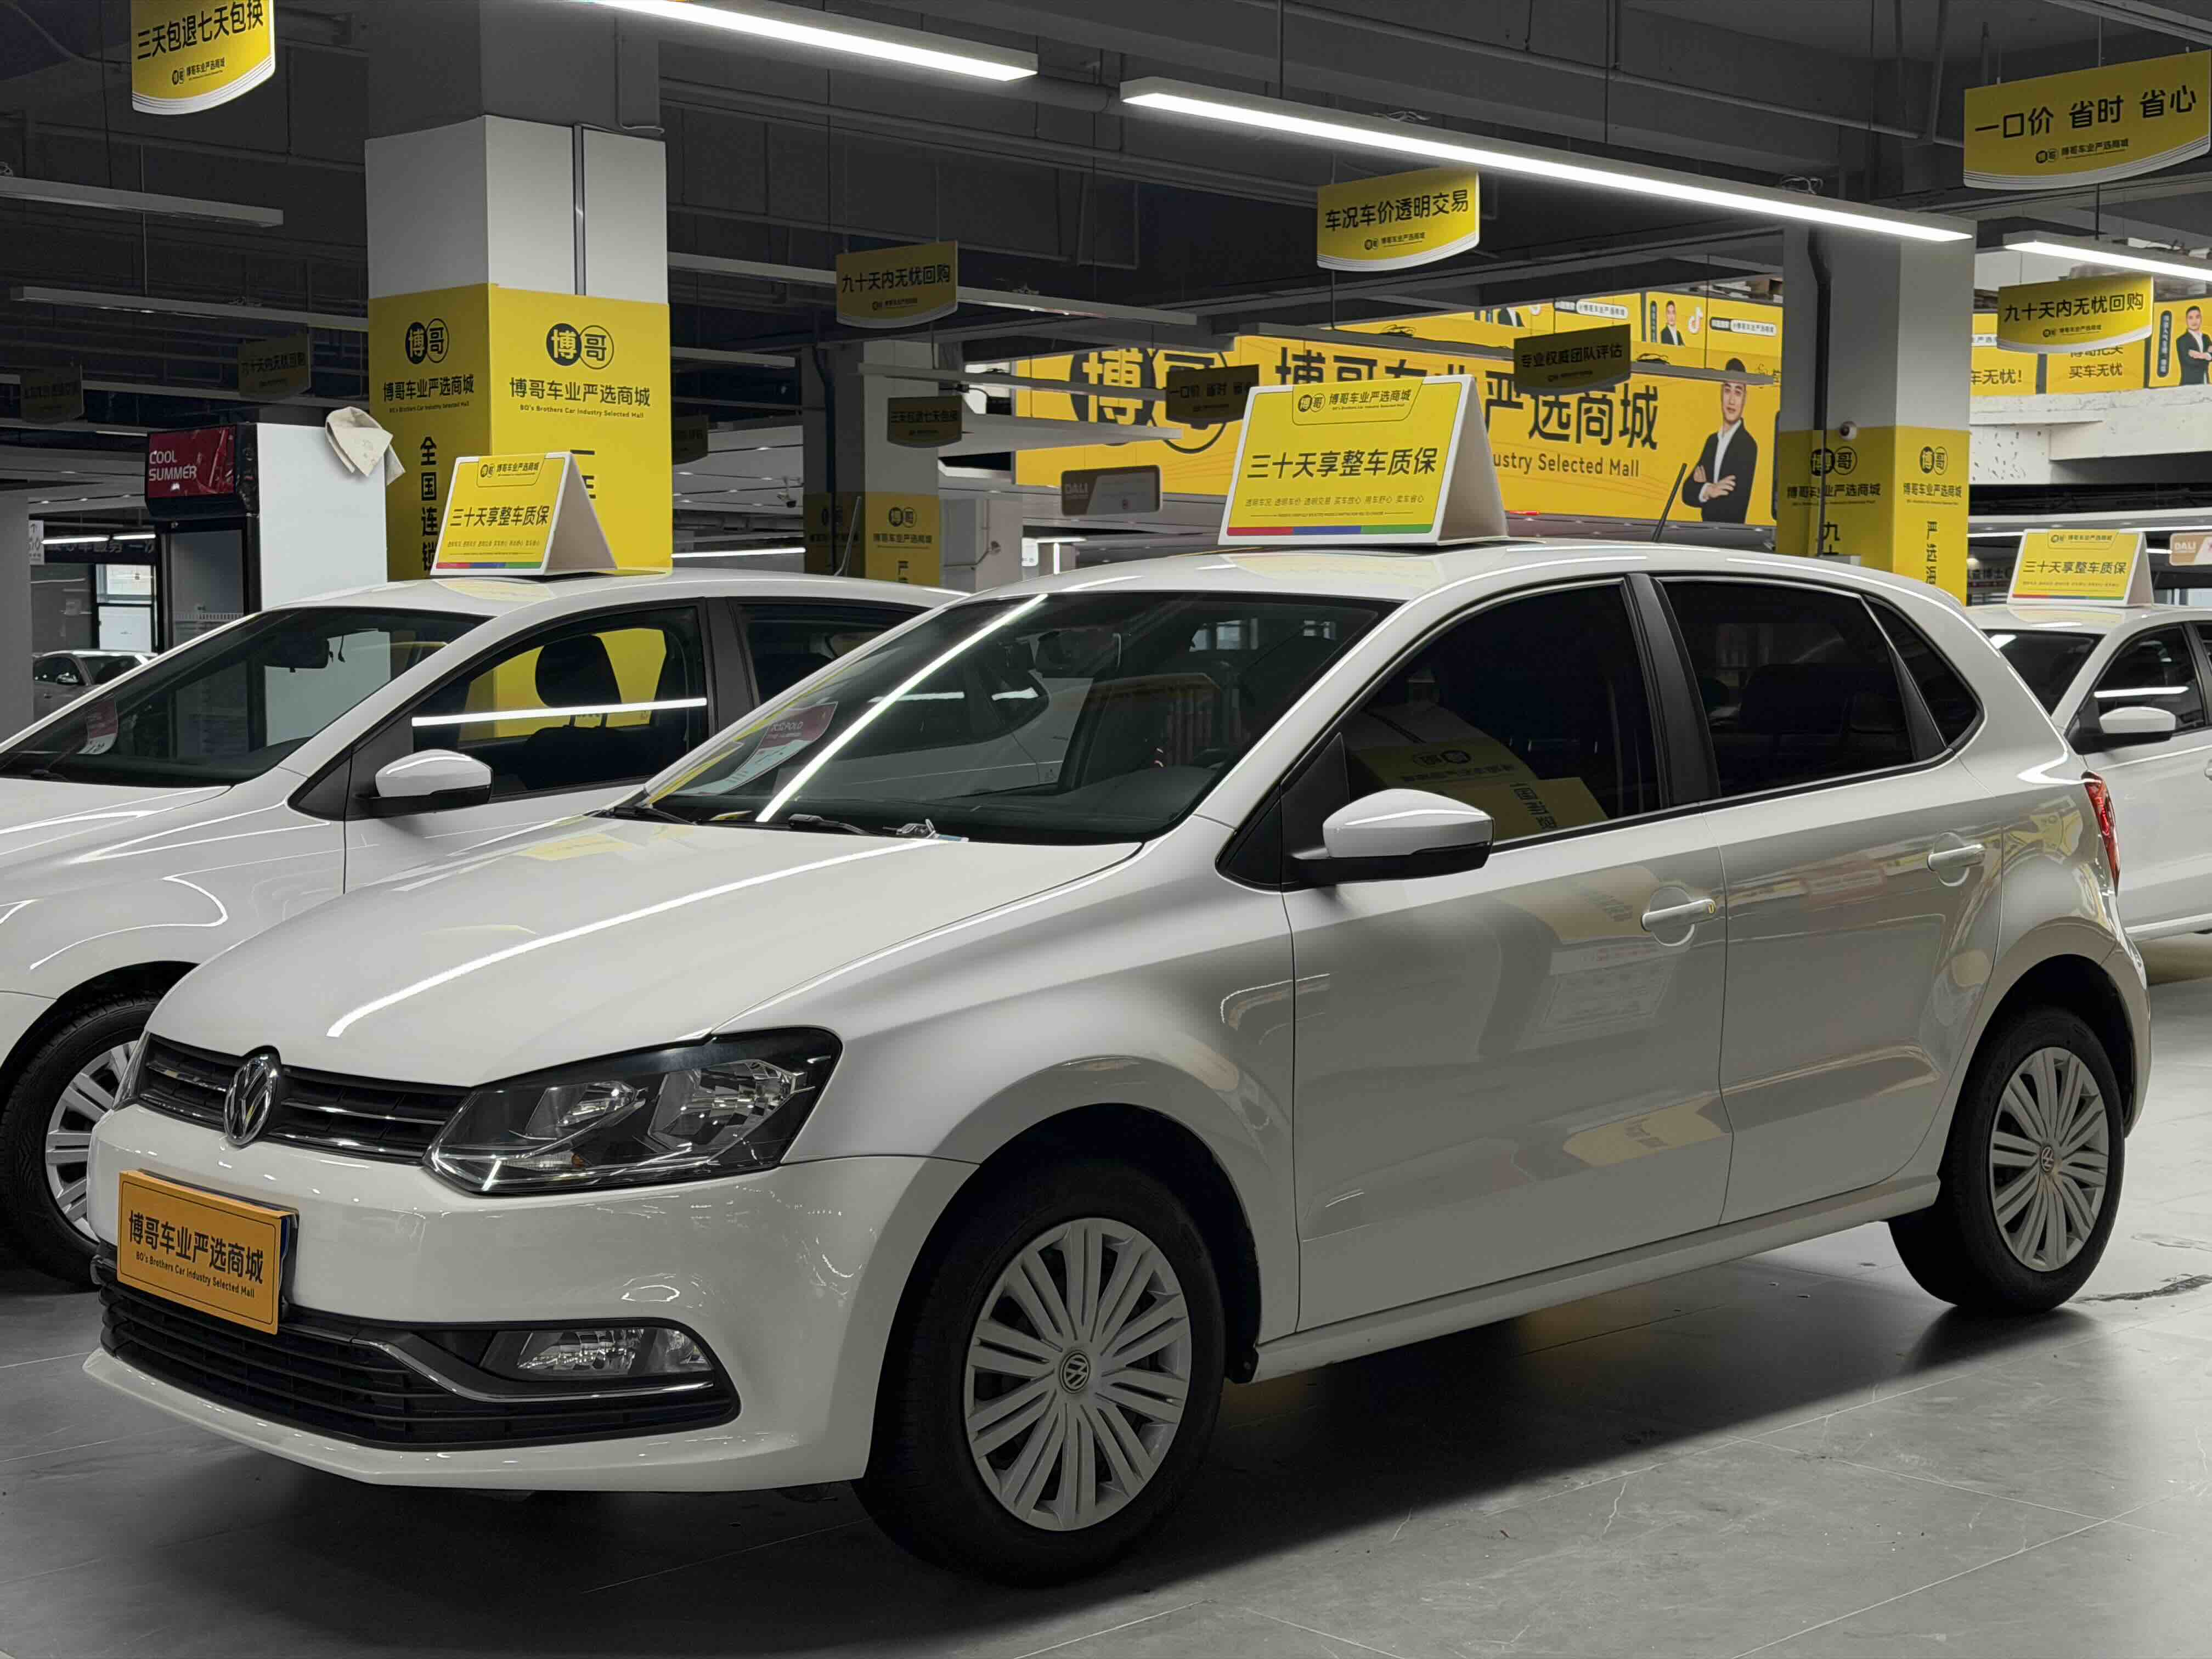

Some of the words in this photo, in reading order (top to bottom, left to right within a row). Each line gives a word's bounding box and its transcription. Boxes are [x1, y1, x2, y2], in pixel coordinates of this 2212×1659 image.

[137, 0, 263, 60] 三天包退七天包换
[1975, 106, 2054, 139] 一口价
[2068, 95, 2124, 129] 省时
[2140, 84, 2197, 119] 省心
[1325, 189, 1469, 232] 车况车价透明交易
[842, 263, 951, 293] 九十天内无忧回购
[2004, 291, 2145, 323] 九十天内无忧回购
[548, 326, 611, 366] 博哥
[1521, 343, 1623, 368] 专业权威团队评估
[2069, 362, 2123, 379] 买车无忧
[383, 373, 475, 402] 博哥车业严选商城
[510, 377, 651, 407] 博哥车业严选商城
[1329, 389, 1412, 405] 博哥车业严选商城
[577, 409, 602, 417] Industry
[150, 450, 178, 465] COOL
[1247, 447, 1438, 479] 三十天享整车质保
[1493, 454, 1532, 472] ustry
[1538, 453, 1604, 475] Selected
[1609, 459, 1639, 478] Mall
[149, 465, 198, 481] SUMMER
[420, 437, 438, 571] 全国连锁
[450, 505, 550, 527] 三十天享整车质保
[2023, 561, 2127, 574] 三十天享整车质保
[129, 1210, 264, 1284] 博哥车业严选商城
[136, 1251, 149, 1263] BO's
[150, 1255, 174, 1273] Brothers
[175, 1265, 185, 1276] Car
[187, 1268, 211, 1286] Industry
[212, 1277, 240, 1293] Selected
[241, 1285, 255, 1299] Mall
